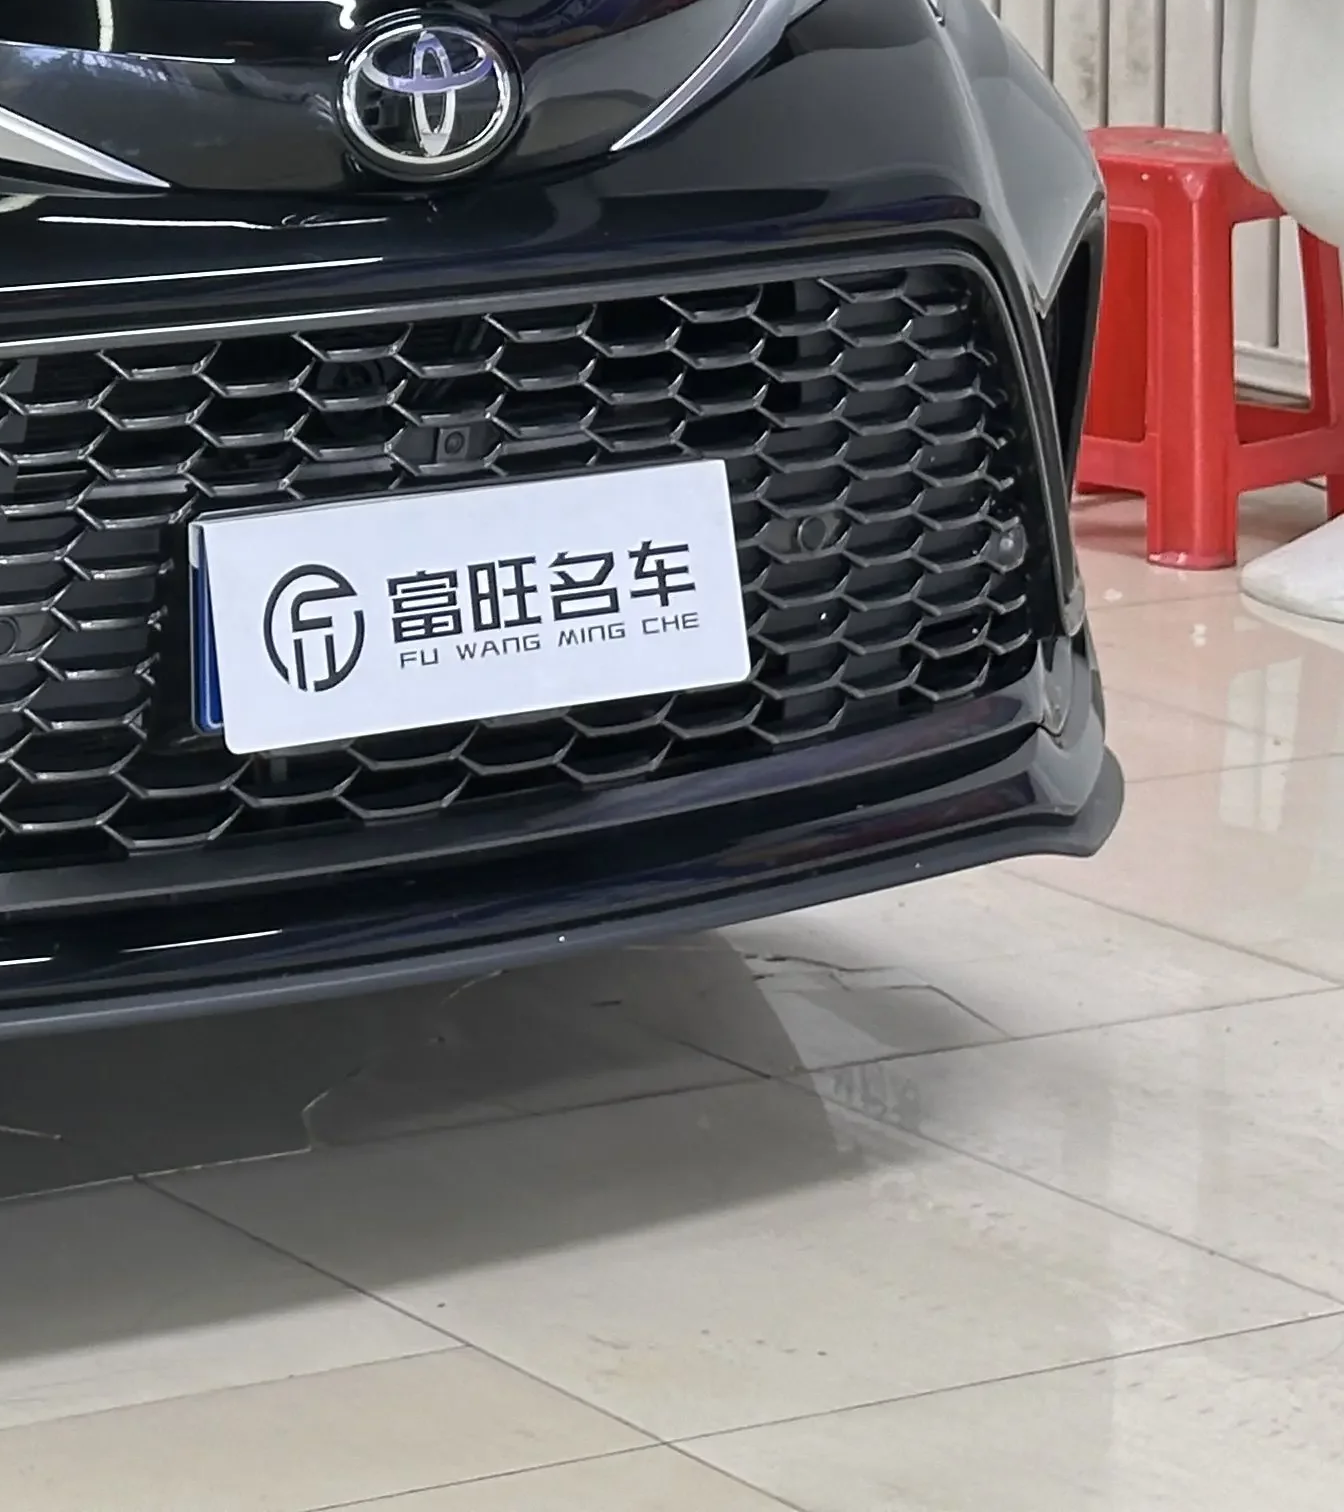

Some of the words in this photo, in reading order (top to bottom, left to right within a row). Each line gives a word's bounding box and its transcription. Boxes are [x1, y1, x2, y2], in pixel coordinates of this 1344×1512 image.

[386, 539, 697, 645] 富旺名车
[399, 647, 440, 669] FU
[456, 633, 542, 659] WANG
[557, 621, 627, 648] MING
[641, 611, 701, 636] CHE
